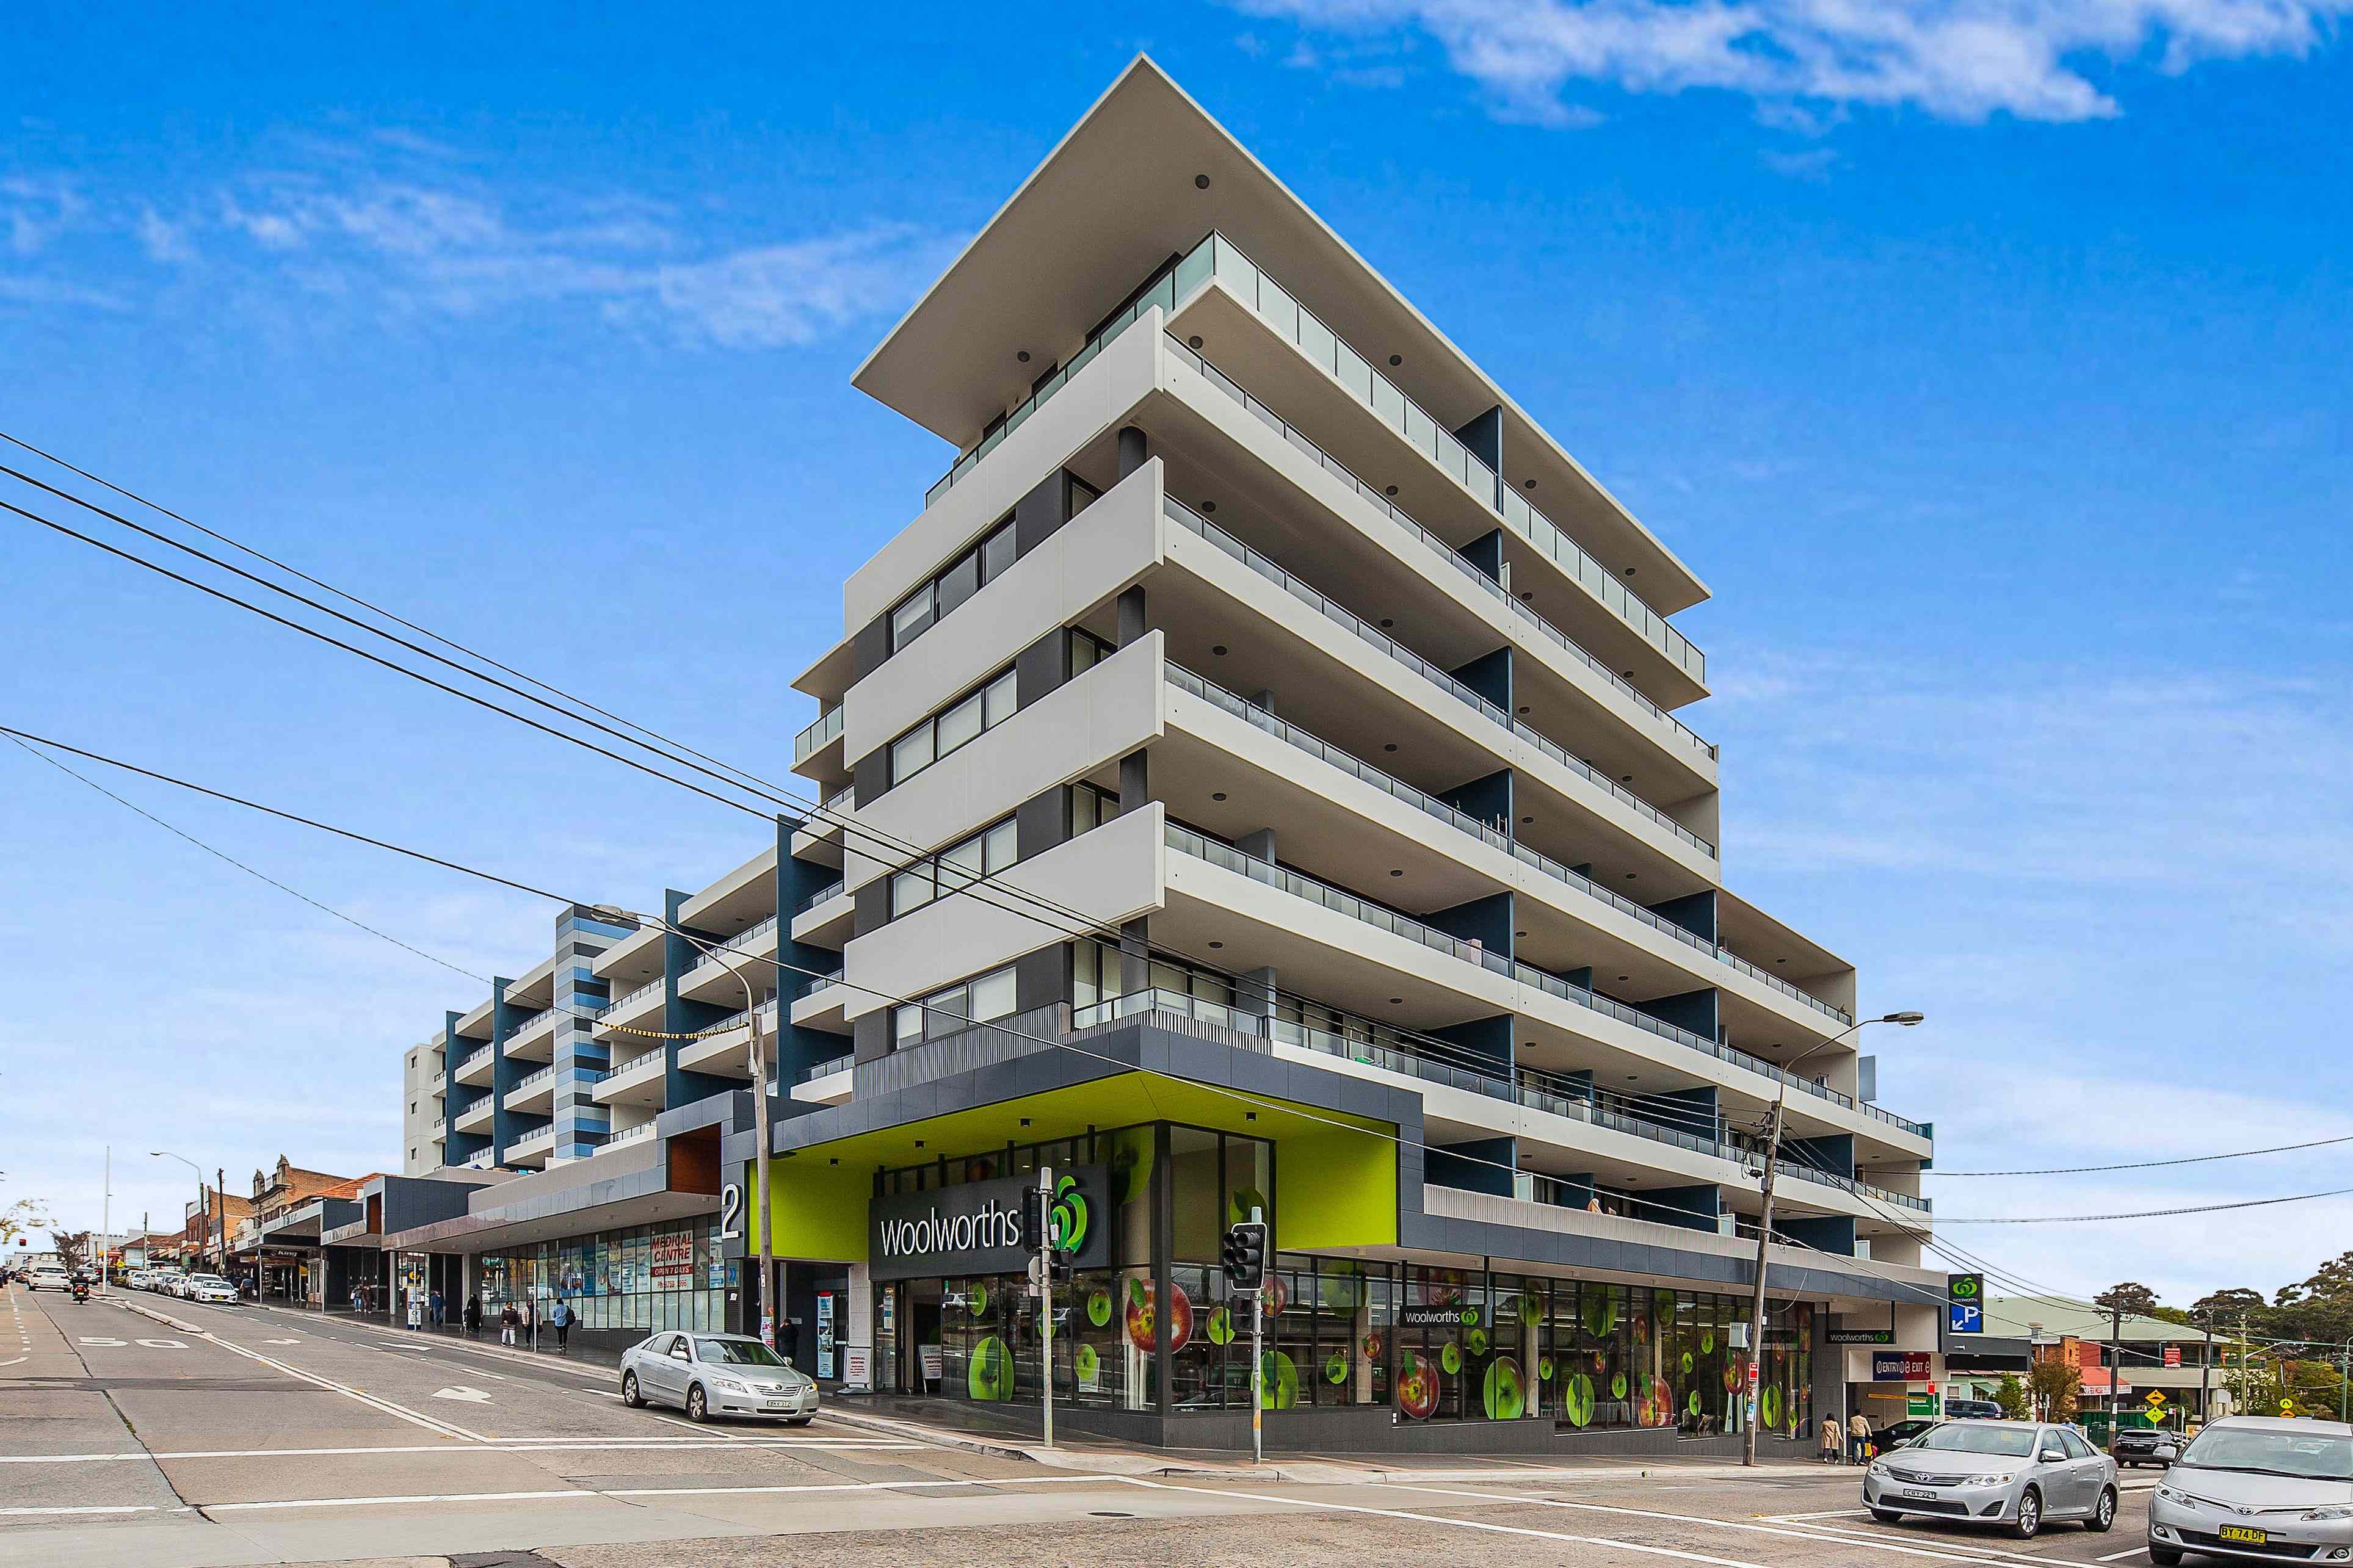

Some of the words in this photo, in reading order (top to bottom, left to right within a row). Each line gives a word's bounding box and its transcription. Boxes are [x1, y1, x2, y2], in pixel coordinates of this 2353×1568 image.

[722, 1183, 739, 1239] 2
[881, 1199, 1019, 1256] woolworths
[651, 1233, 692, 1250] MEDICAL
[674, 1265, 689, 1274] DAYS
[1405, 1310, 1460, 1323] woolworths
[1965, 1306, 1978, 1323] P
[1830, 1333, 1874, 1342] woolworths
[1882, 1362, 1899, 1373] ENTRY
[1912, 1362, 1923, 1372] EXIT
